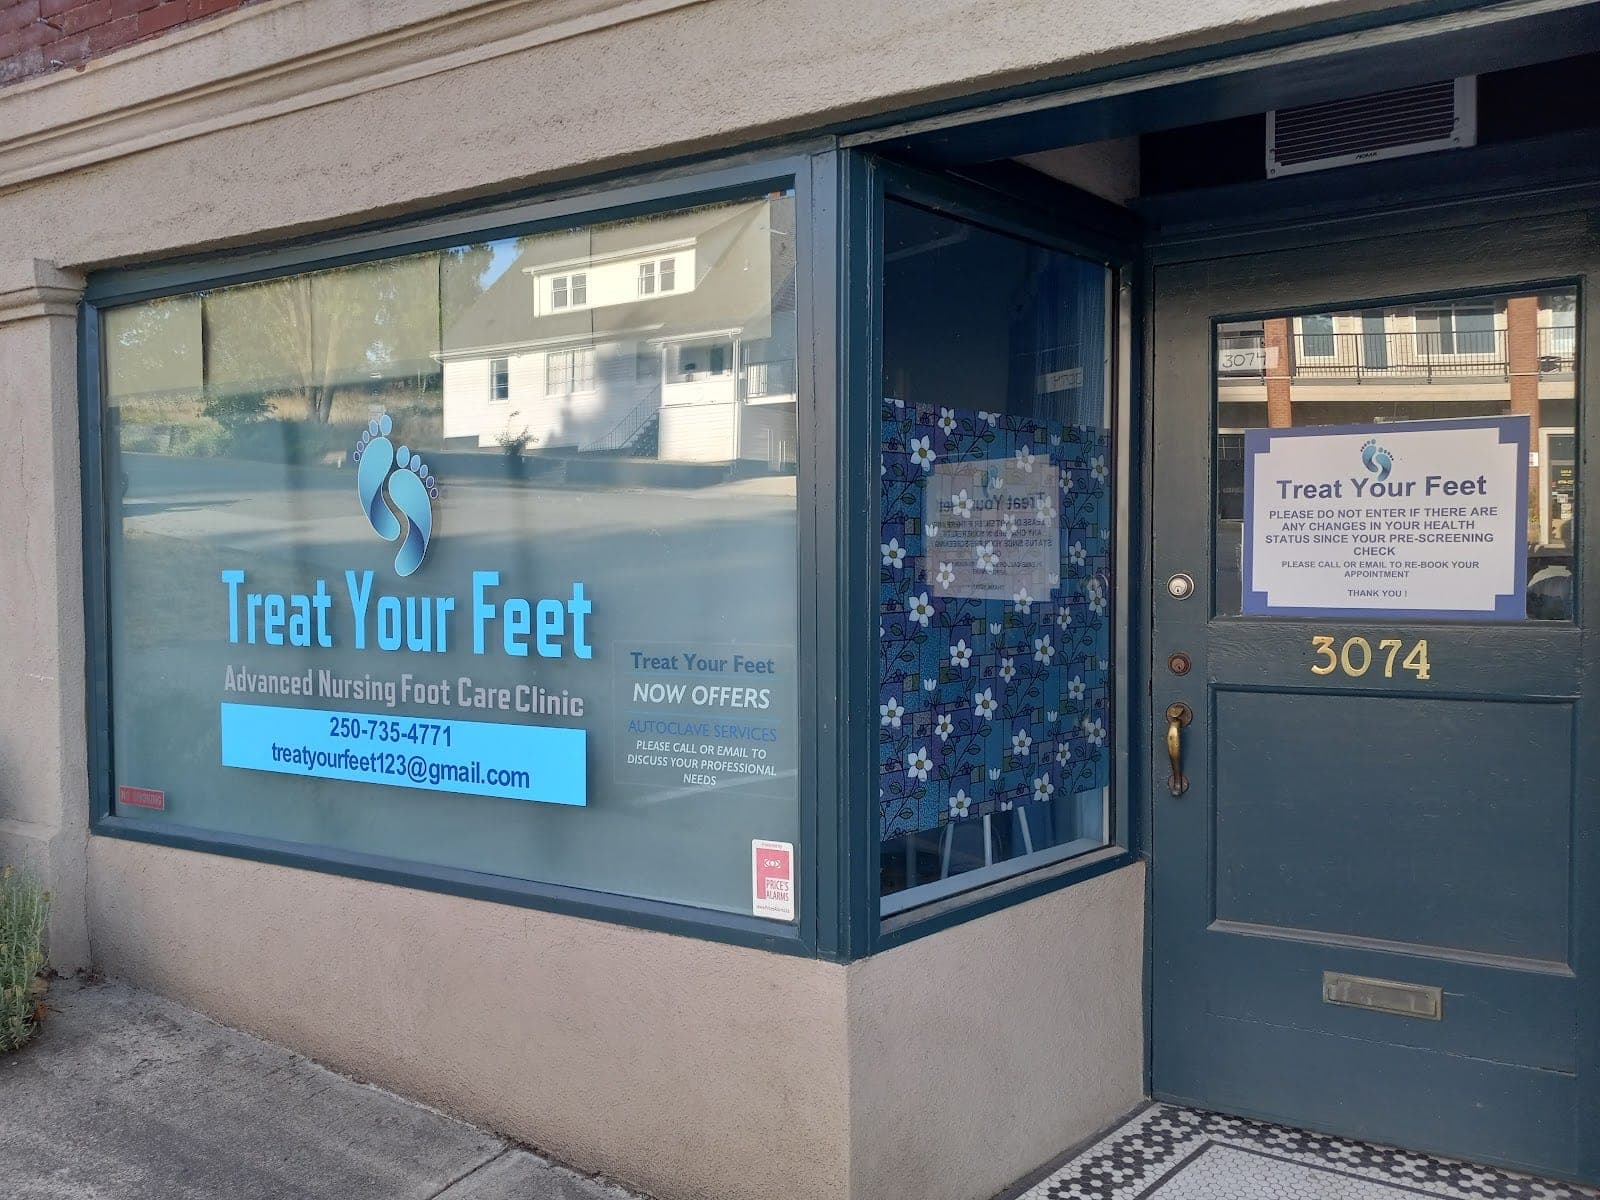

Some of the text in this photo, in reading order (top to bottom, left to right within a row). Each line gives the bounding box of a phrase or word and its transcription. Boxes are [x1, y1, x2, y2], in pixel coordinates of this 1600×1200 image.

[1222, 352, 1266, 368] 3074
[1276, 475, 1487, 499] Treat Your Feet
[1269, 506, 1498, 519] PLEASE DO NOT ENTER IF THERE ARE
[1281, 520, 1475, 532] ANY CHANGES IN YOUR HEALTH
[1265, 533, 1494, 544] STATUS SINCE YOUR PRE-SCREENING
[1353, 546, 1396, 556] CHECK
[1281, 560, 1480, 569] PLEASE CALL OR EMAIL TO RE-BOOK YOUR
[1344, 570, 1410, 578] APPOINTMENT
[1347, 589, 1379, 597] THANK
[1382, 589, 1402, 598] YOU
[221, 569, 593, 659] Treat Your Feet
[630, 652, 775, 674] Treat Your Feet
[1310, 635, 1431, 680] 3074
[224, 664, 584, 717] Advanced Nursing Foot Care Clinic
[633, 683, 770, 709] NOW OFFERS
[329, 716, 452, 747] 250-735-4771
[627, 720, 777, 742] AUTOCLAVE SERVICES
[636, 740, 767, 760] PLEASE CALL OR EMAIL TO
[271, 742, 530, 789] treatyourfeet123@gmail.com
[627, 754, 777, 776] DISCUSS YOUR PROFESSIONAL
[683, 773, 717, 786] NEEDS
[766, 879, 789, 892] PRICE'S
[766, 890, 789, 901] ALARMS
